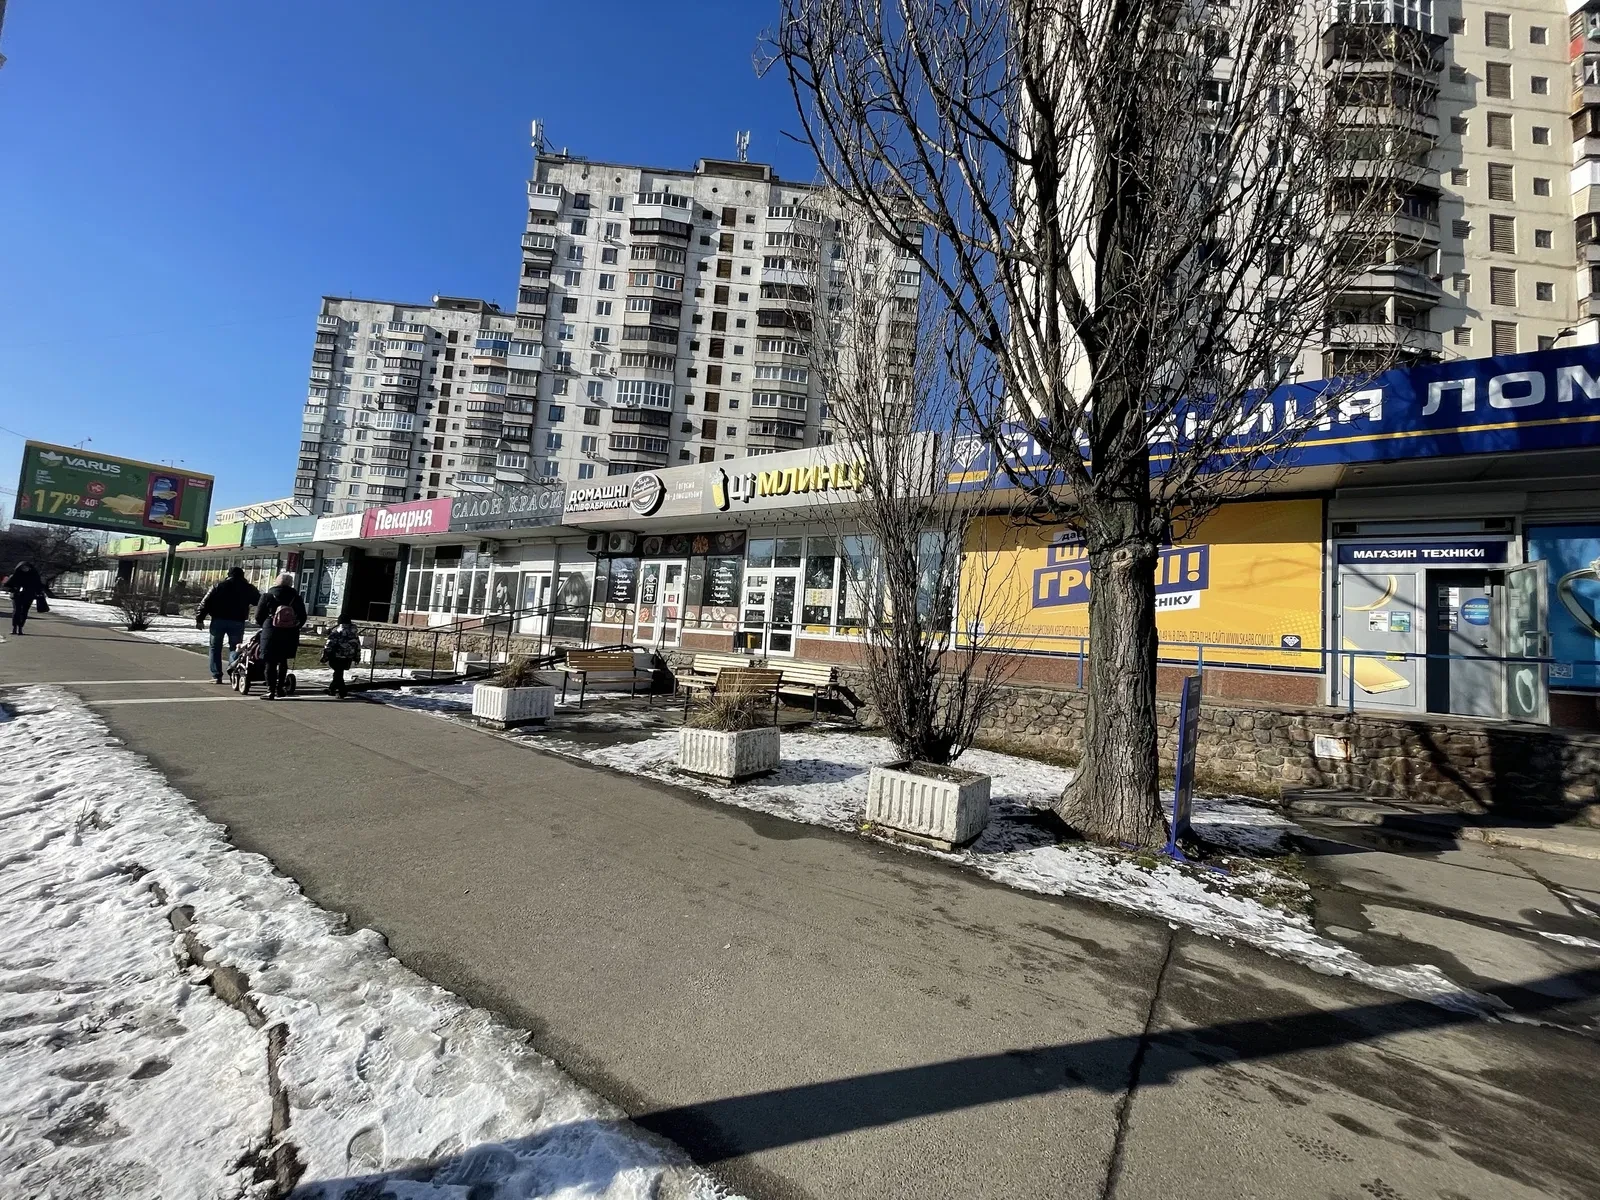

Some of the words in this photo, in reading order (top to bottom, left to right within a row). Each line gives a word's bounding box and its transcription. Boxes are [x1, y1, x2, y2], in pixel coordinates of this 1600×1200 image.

[65, 456, 121, 474] VARUS
[569, 484, 628, 503] ДОМАШНІ
[452, 497, 503, 519] САЛОН
[508, 490, 564, 513] КРАСИ
[565, 500, 629, 513] НАПІВФАБРИКАТИ
[330, 518, 354, 532] ВІКНА
[375, 508, 433, 532] Пекарня
[1353, 549, 1417, 559] МАГАЗИН
[1421, 548, 1485, 558] ТЕХНІКИ
